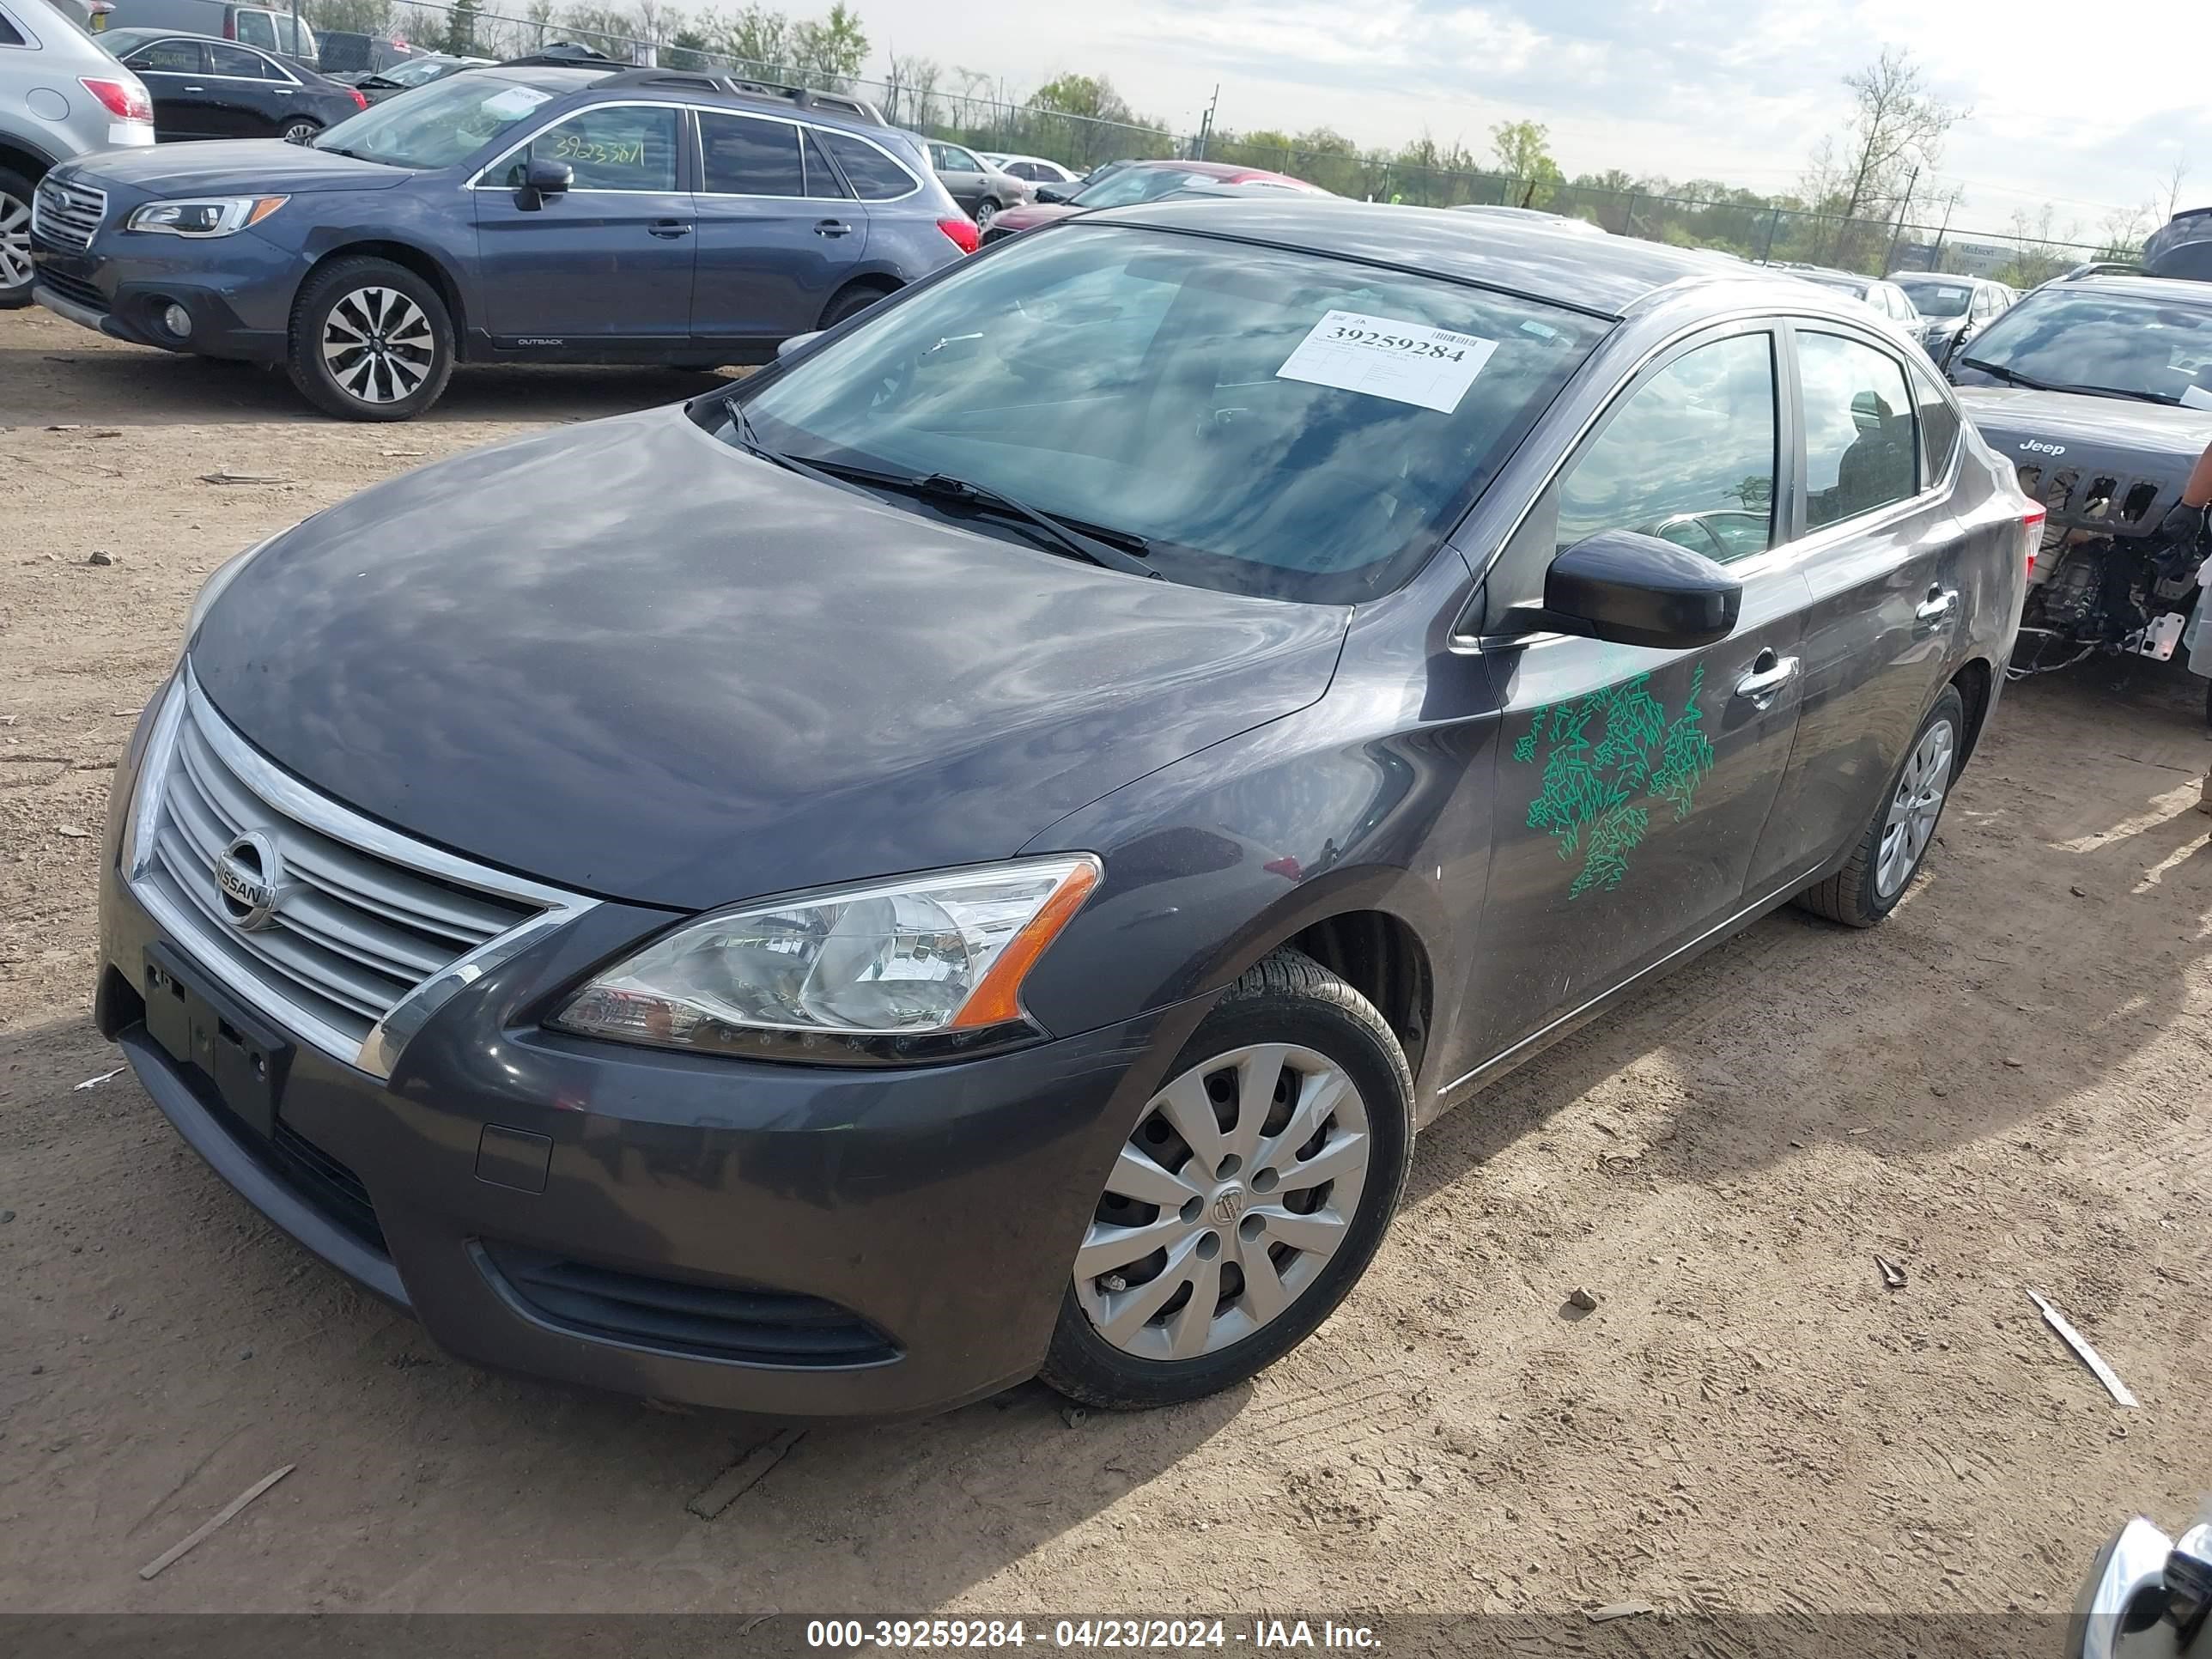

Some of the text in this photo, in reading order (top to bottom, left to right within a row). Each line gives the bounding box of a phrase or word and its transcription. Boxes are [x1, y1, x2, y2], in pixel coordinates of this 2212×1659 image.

[1327, 326, 1466, 362] 39259284
[2019, 439, 2066, 456] Jeep
[215, 860, 262, 903] NISSAN
